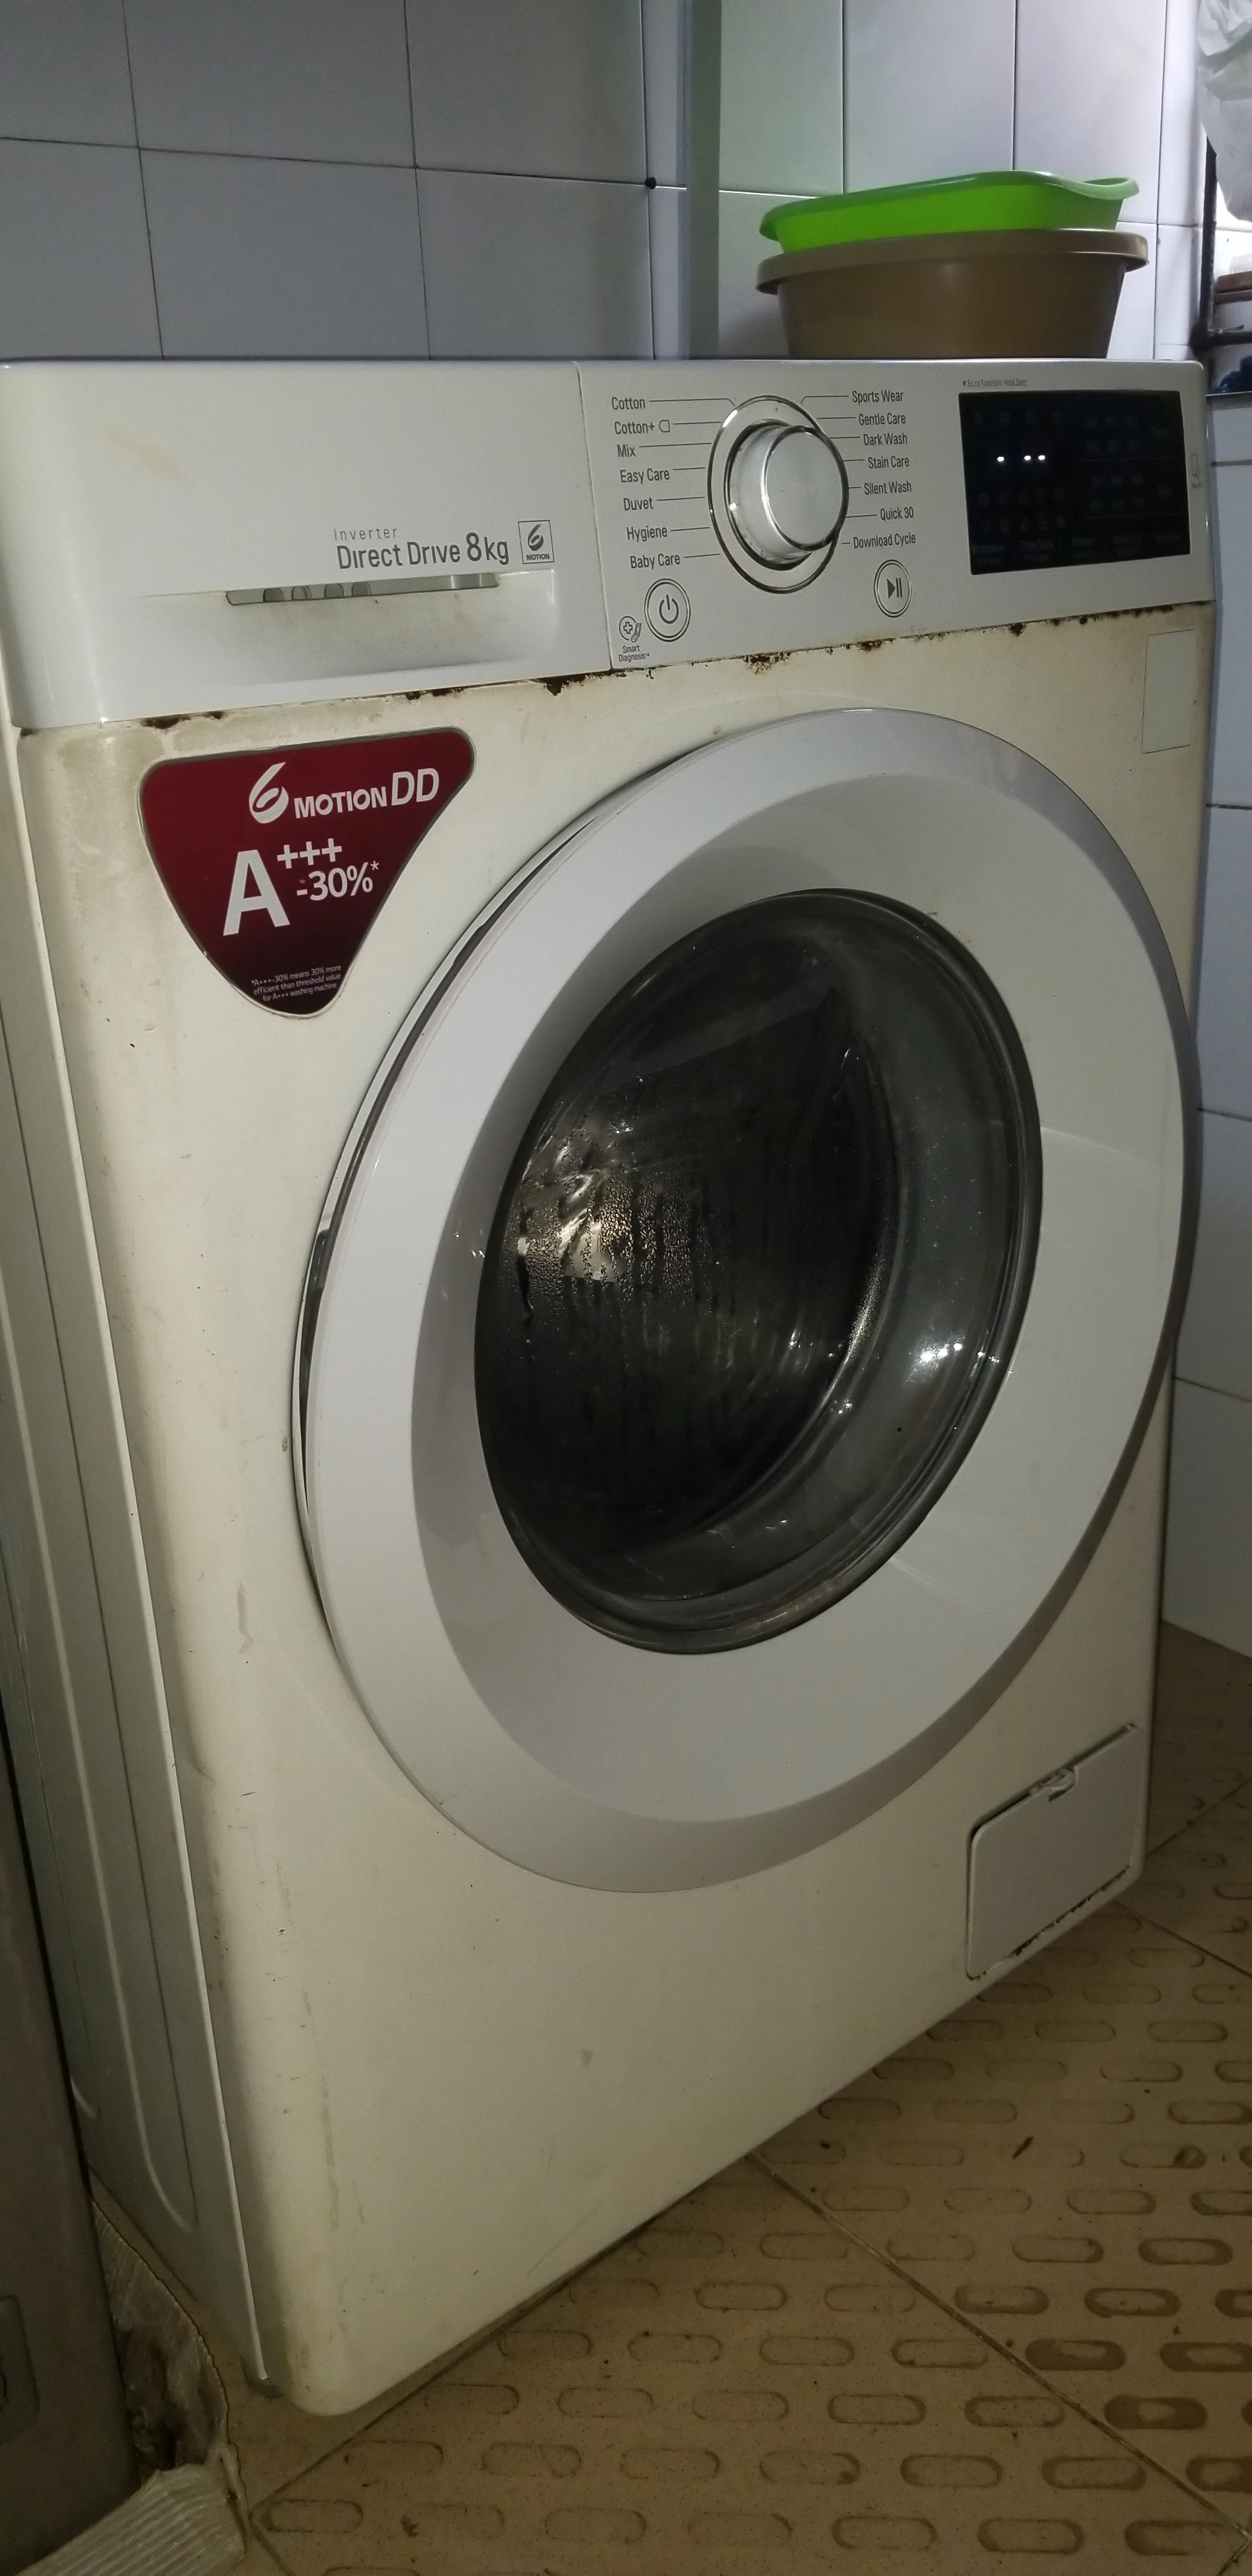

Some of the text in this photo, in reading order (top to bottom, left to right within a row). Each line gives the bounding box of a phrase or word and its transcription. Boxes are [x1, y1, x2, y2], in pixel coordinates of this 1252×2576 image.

[611, 396, 646, 410] Cotton
[852, 389, 903, 405] Sports Wear
[859, 412, 906, 425] Gentle Care
[615, 421, 655, 434] Cotton+
[863, 433, 907, 446] Dark Wash
[616, 443, 636, 457] Mix
[867, 456, 910, 469] Stain Care
[620, 468, 670, 484] Easy Care
[864, 480, 912, 495] Silent Wash
[623, 497, 653, 510] Duvet
[880, 506, 913, 521] Quick 30
[333, 527, 397, 541] Inverter
[626, 525, 668, 542] Hygiene
[853, 532, 916, 549] Download Cycle
[337, 544, 403, 569] Direct
[407, 541, 461, 565] Drive
[630, 553, 680, 570] Baby Care
[622, 645, 640, 653] Smart
[294, 786, 388, 819] MOTION
[392, 767, 439, 806] DD
[289, 971, 310, 979] means
[311, 967, 325, 976] 30%
[254, 973, 341, 995] efficient than threshold value
[289, 986, 314, 996] washing
[314, 983, 337, 992] machine
